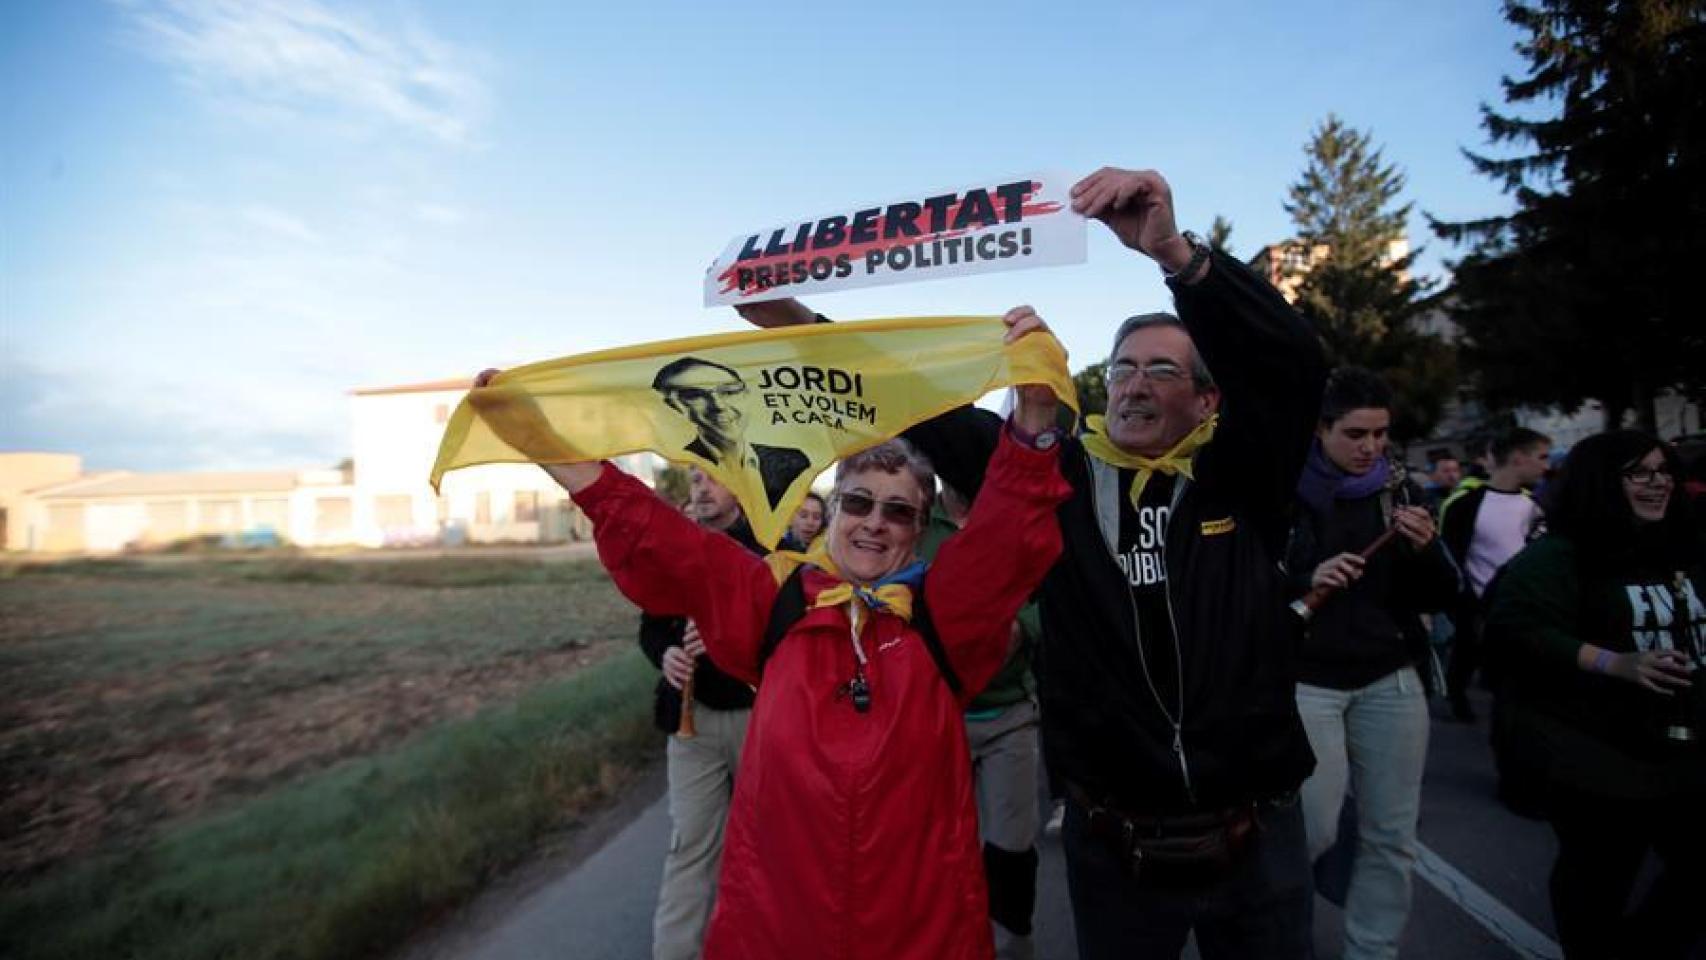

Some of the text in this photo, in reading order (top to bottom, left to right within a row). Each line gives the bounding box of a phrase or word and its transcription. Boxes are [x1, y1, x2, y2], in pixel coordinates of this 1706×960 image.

[737, 180, 1032, 262] LLIBERTAT
[737, 227, 1032, 291] PRESOS POLÍTICS!
[758, 366, 863, 398] JORDI
[763, 393, 876, 426] ET VOLEM
[771, 410, 787, 426] A
